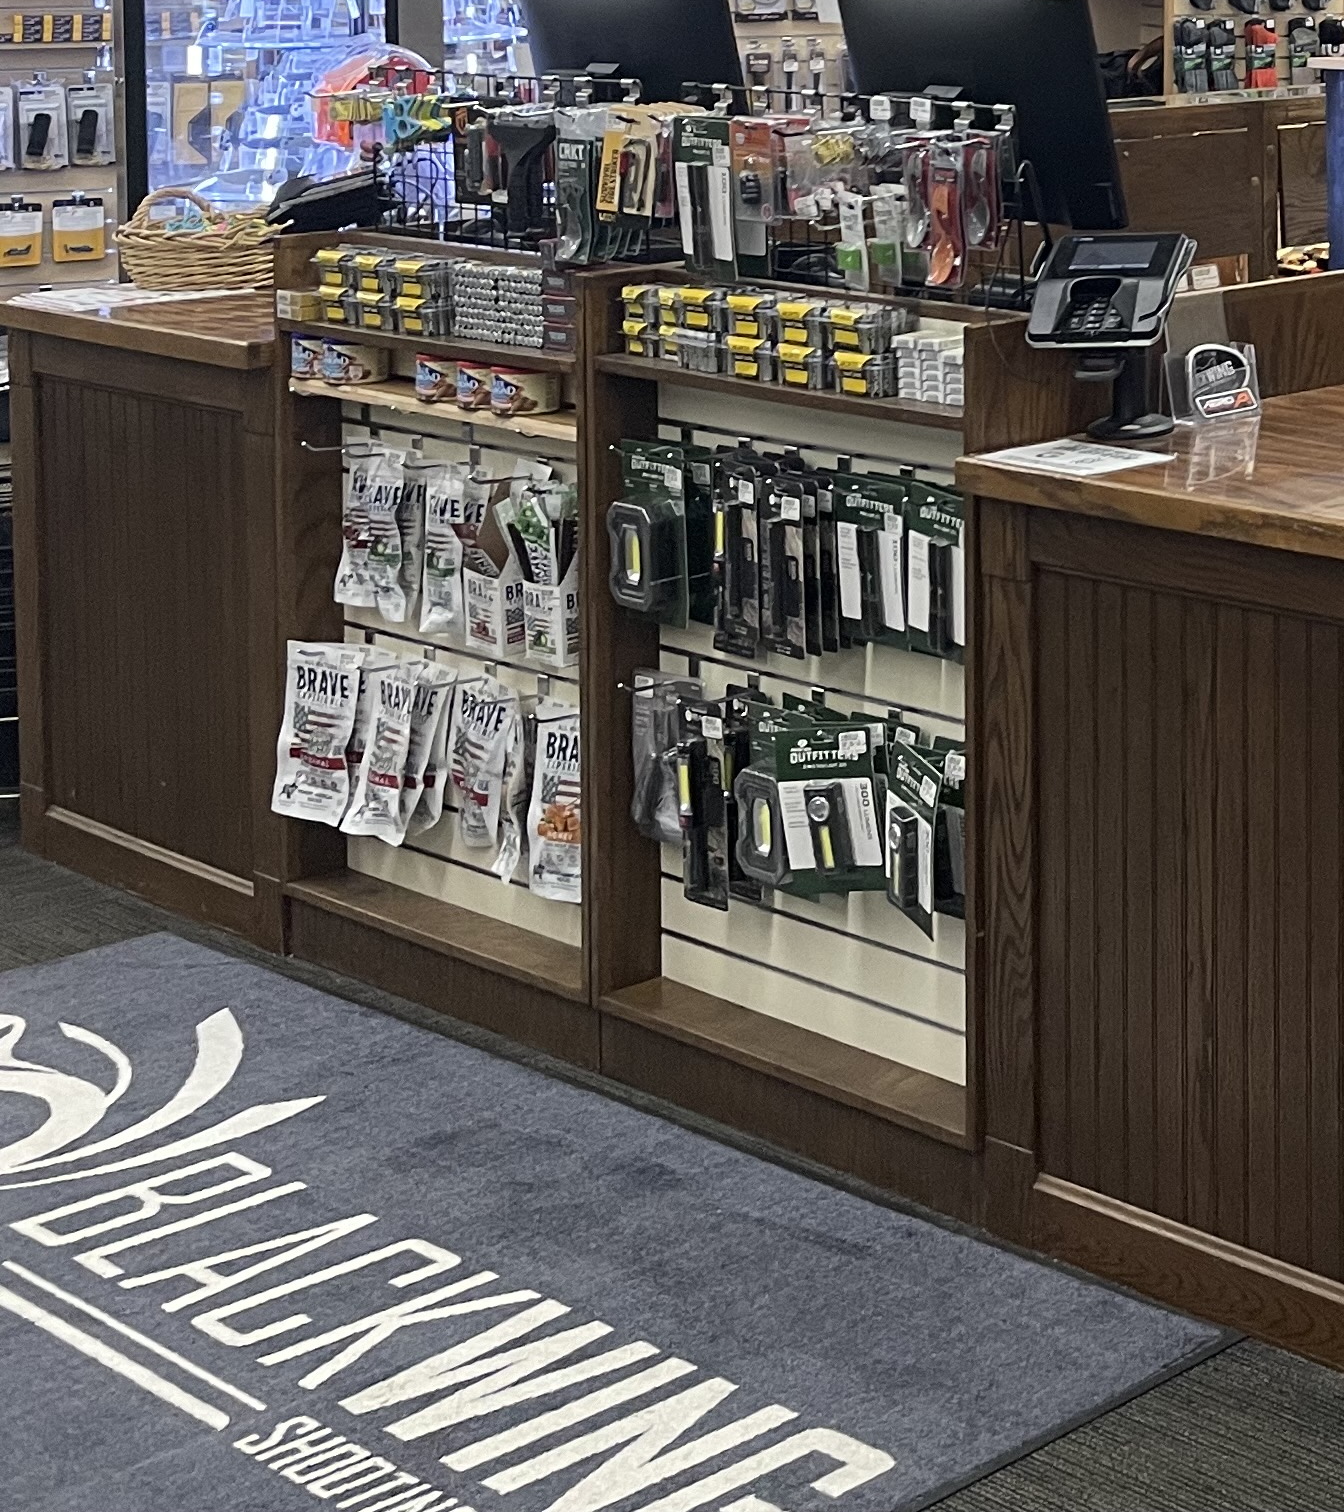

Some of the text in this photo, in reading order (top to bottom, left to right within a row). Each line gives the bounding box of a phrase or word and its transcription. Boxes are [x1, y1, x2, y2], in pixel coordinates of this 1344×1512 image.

[296, 665, 349, 699] BRAVE
[462, 689, 506, 732] BRAVE
[546, 731, 580, 763] BRA
